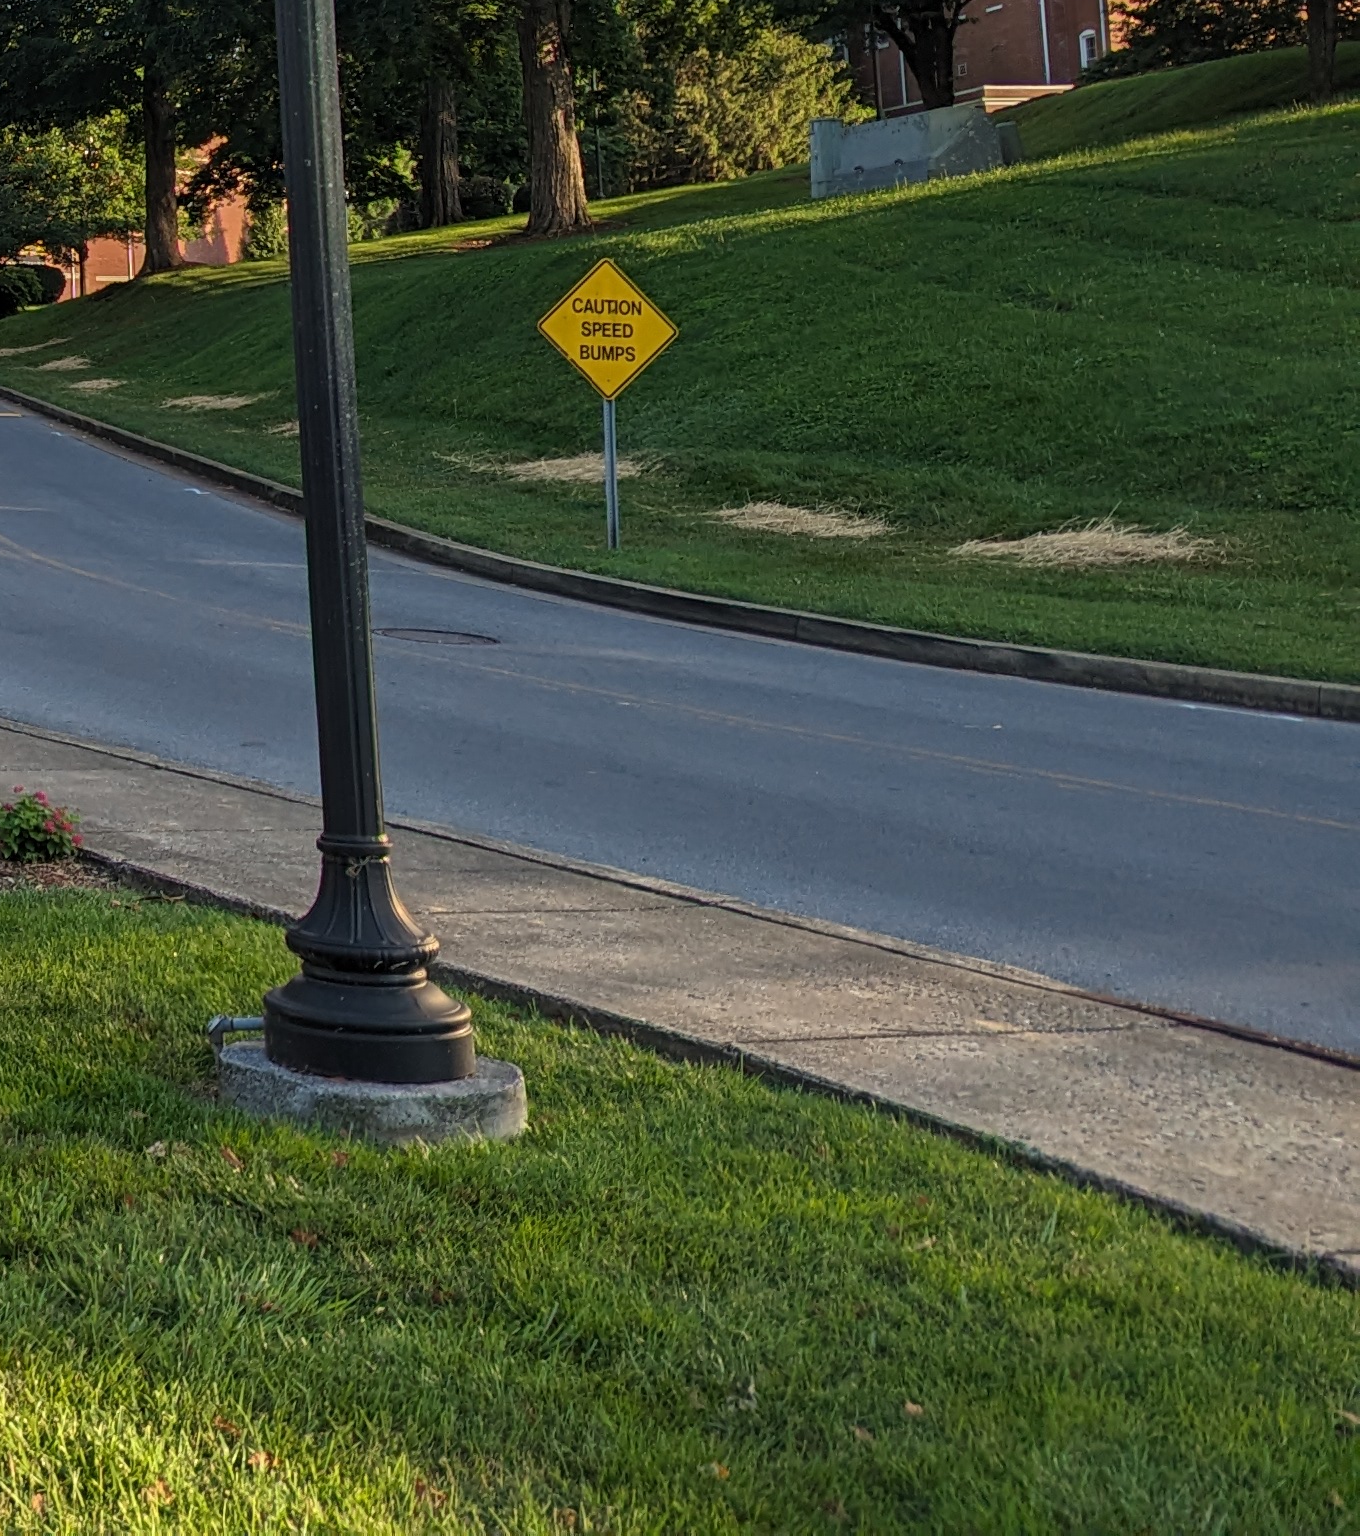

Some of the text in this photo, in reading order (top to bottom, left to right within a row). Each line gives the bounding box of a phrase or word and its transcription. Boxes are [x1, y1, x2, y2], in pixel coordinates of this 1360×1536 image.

[572, 298, 642, 315] CAUTION
[581, 321, 634, 338] SPEED
[580, 345, 636, 362] BUMPS
